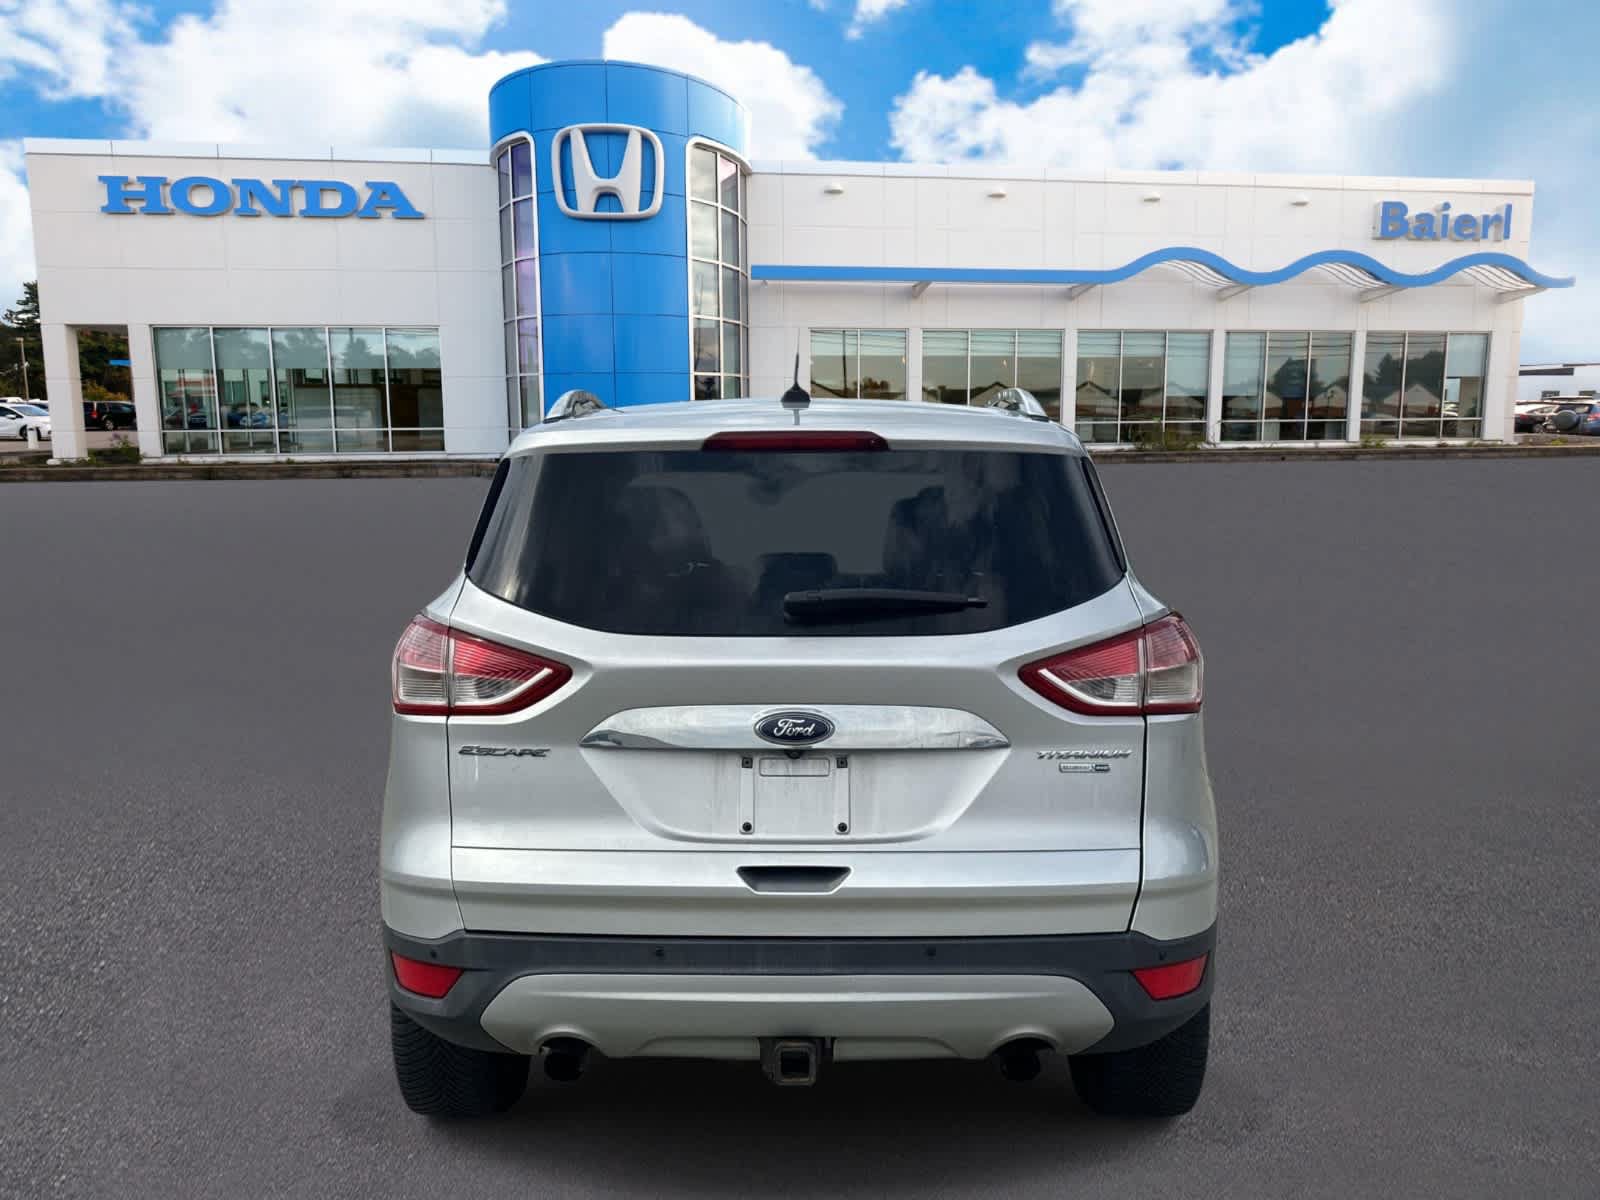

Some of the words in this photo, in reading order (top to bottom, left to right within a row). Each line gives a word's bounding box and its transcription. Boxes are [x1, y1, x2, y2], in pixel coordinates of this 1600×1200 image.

[98, 175, 425, 219] HONDA
[1379, 200, 1513, 241] Baierl
[773, 718, 816, 737] Ford
[458, 744, 551, 758] ESCAPE
[1037, 749, 1132, 760] TITANIUM
